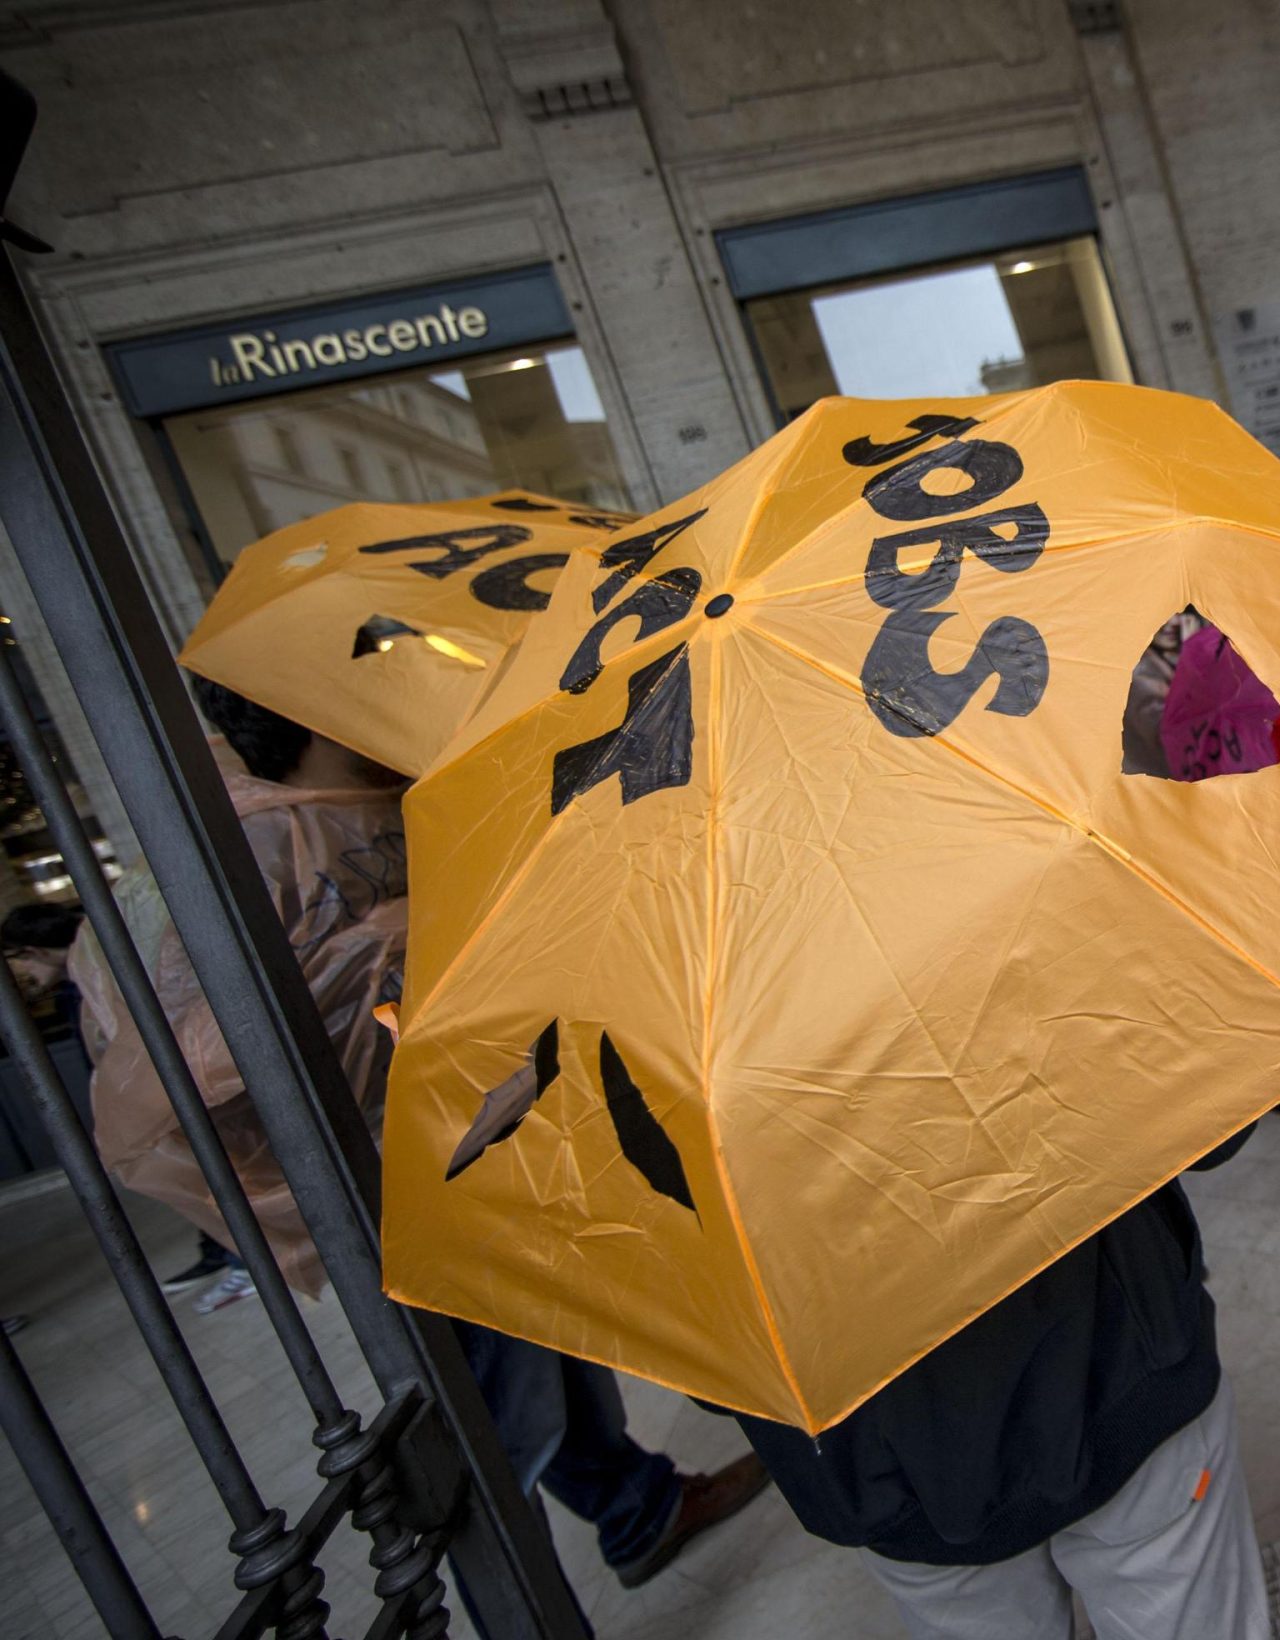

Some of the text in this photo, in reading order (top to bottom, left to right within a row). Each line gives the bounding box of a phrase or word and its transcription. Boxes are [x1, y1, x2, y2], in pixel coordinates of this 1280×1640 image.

[359, 523, 570, 612] AC
[551, 507, 709, 817] ACT
[842, 413, 1050, 738] JOBS
